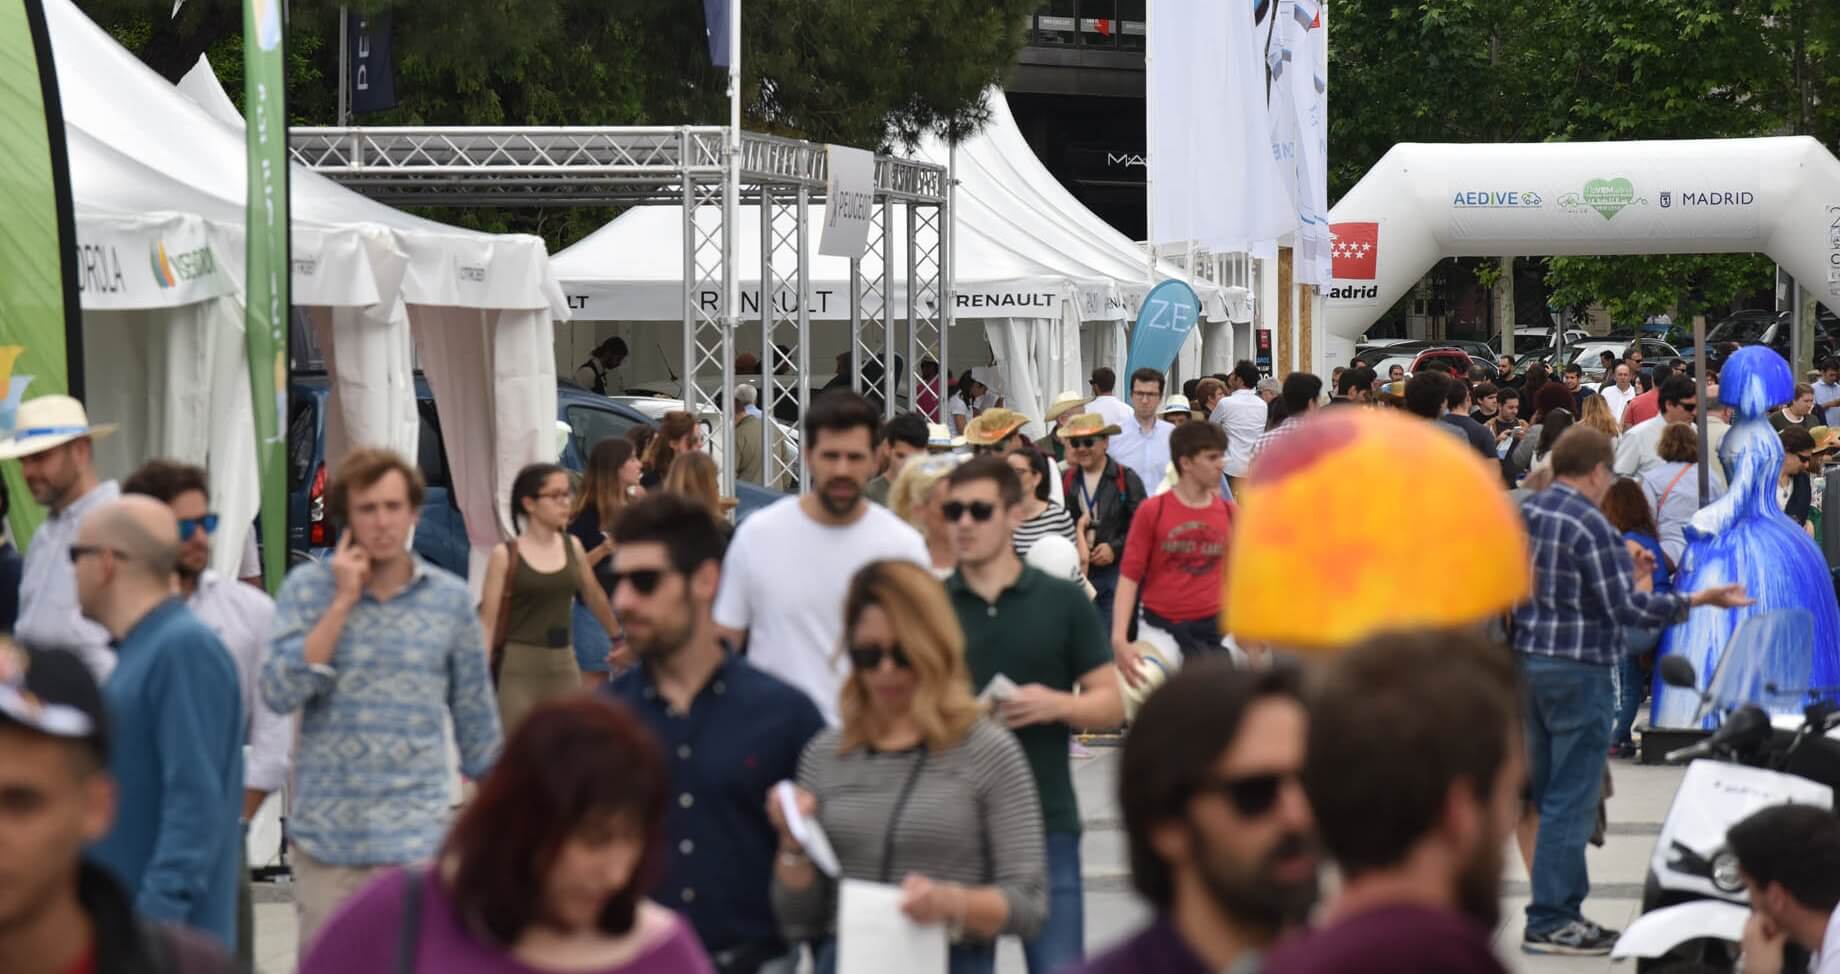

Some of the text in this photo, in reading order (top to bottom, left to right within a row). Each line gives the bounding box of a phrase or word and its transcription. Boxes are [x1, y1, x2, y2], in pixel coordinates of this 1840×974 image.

[357, 21, 369, 90] PE
[1107, 153, 1147, 167] MA
[1454, 192, 1519, 205] AEDIVE
[1683, 192, 1754, 206] MADRID
[75, 244, 127, 293] DROLA
[1326, 285, 1378, 299] adrid
[567, 296, 589, 309] LT
[701, 291, 833, 313] RNUT
[956, 294, 1056, 307] RENAULT
